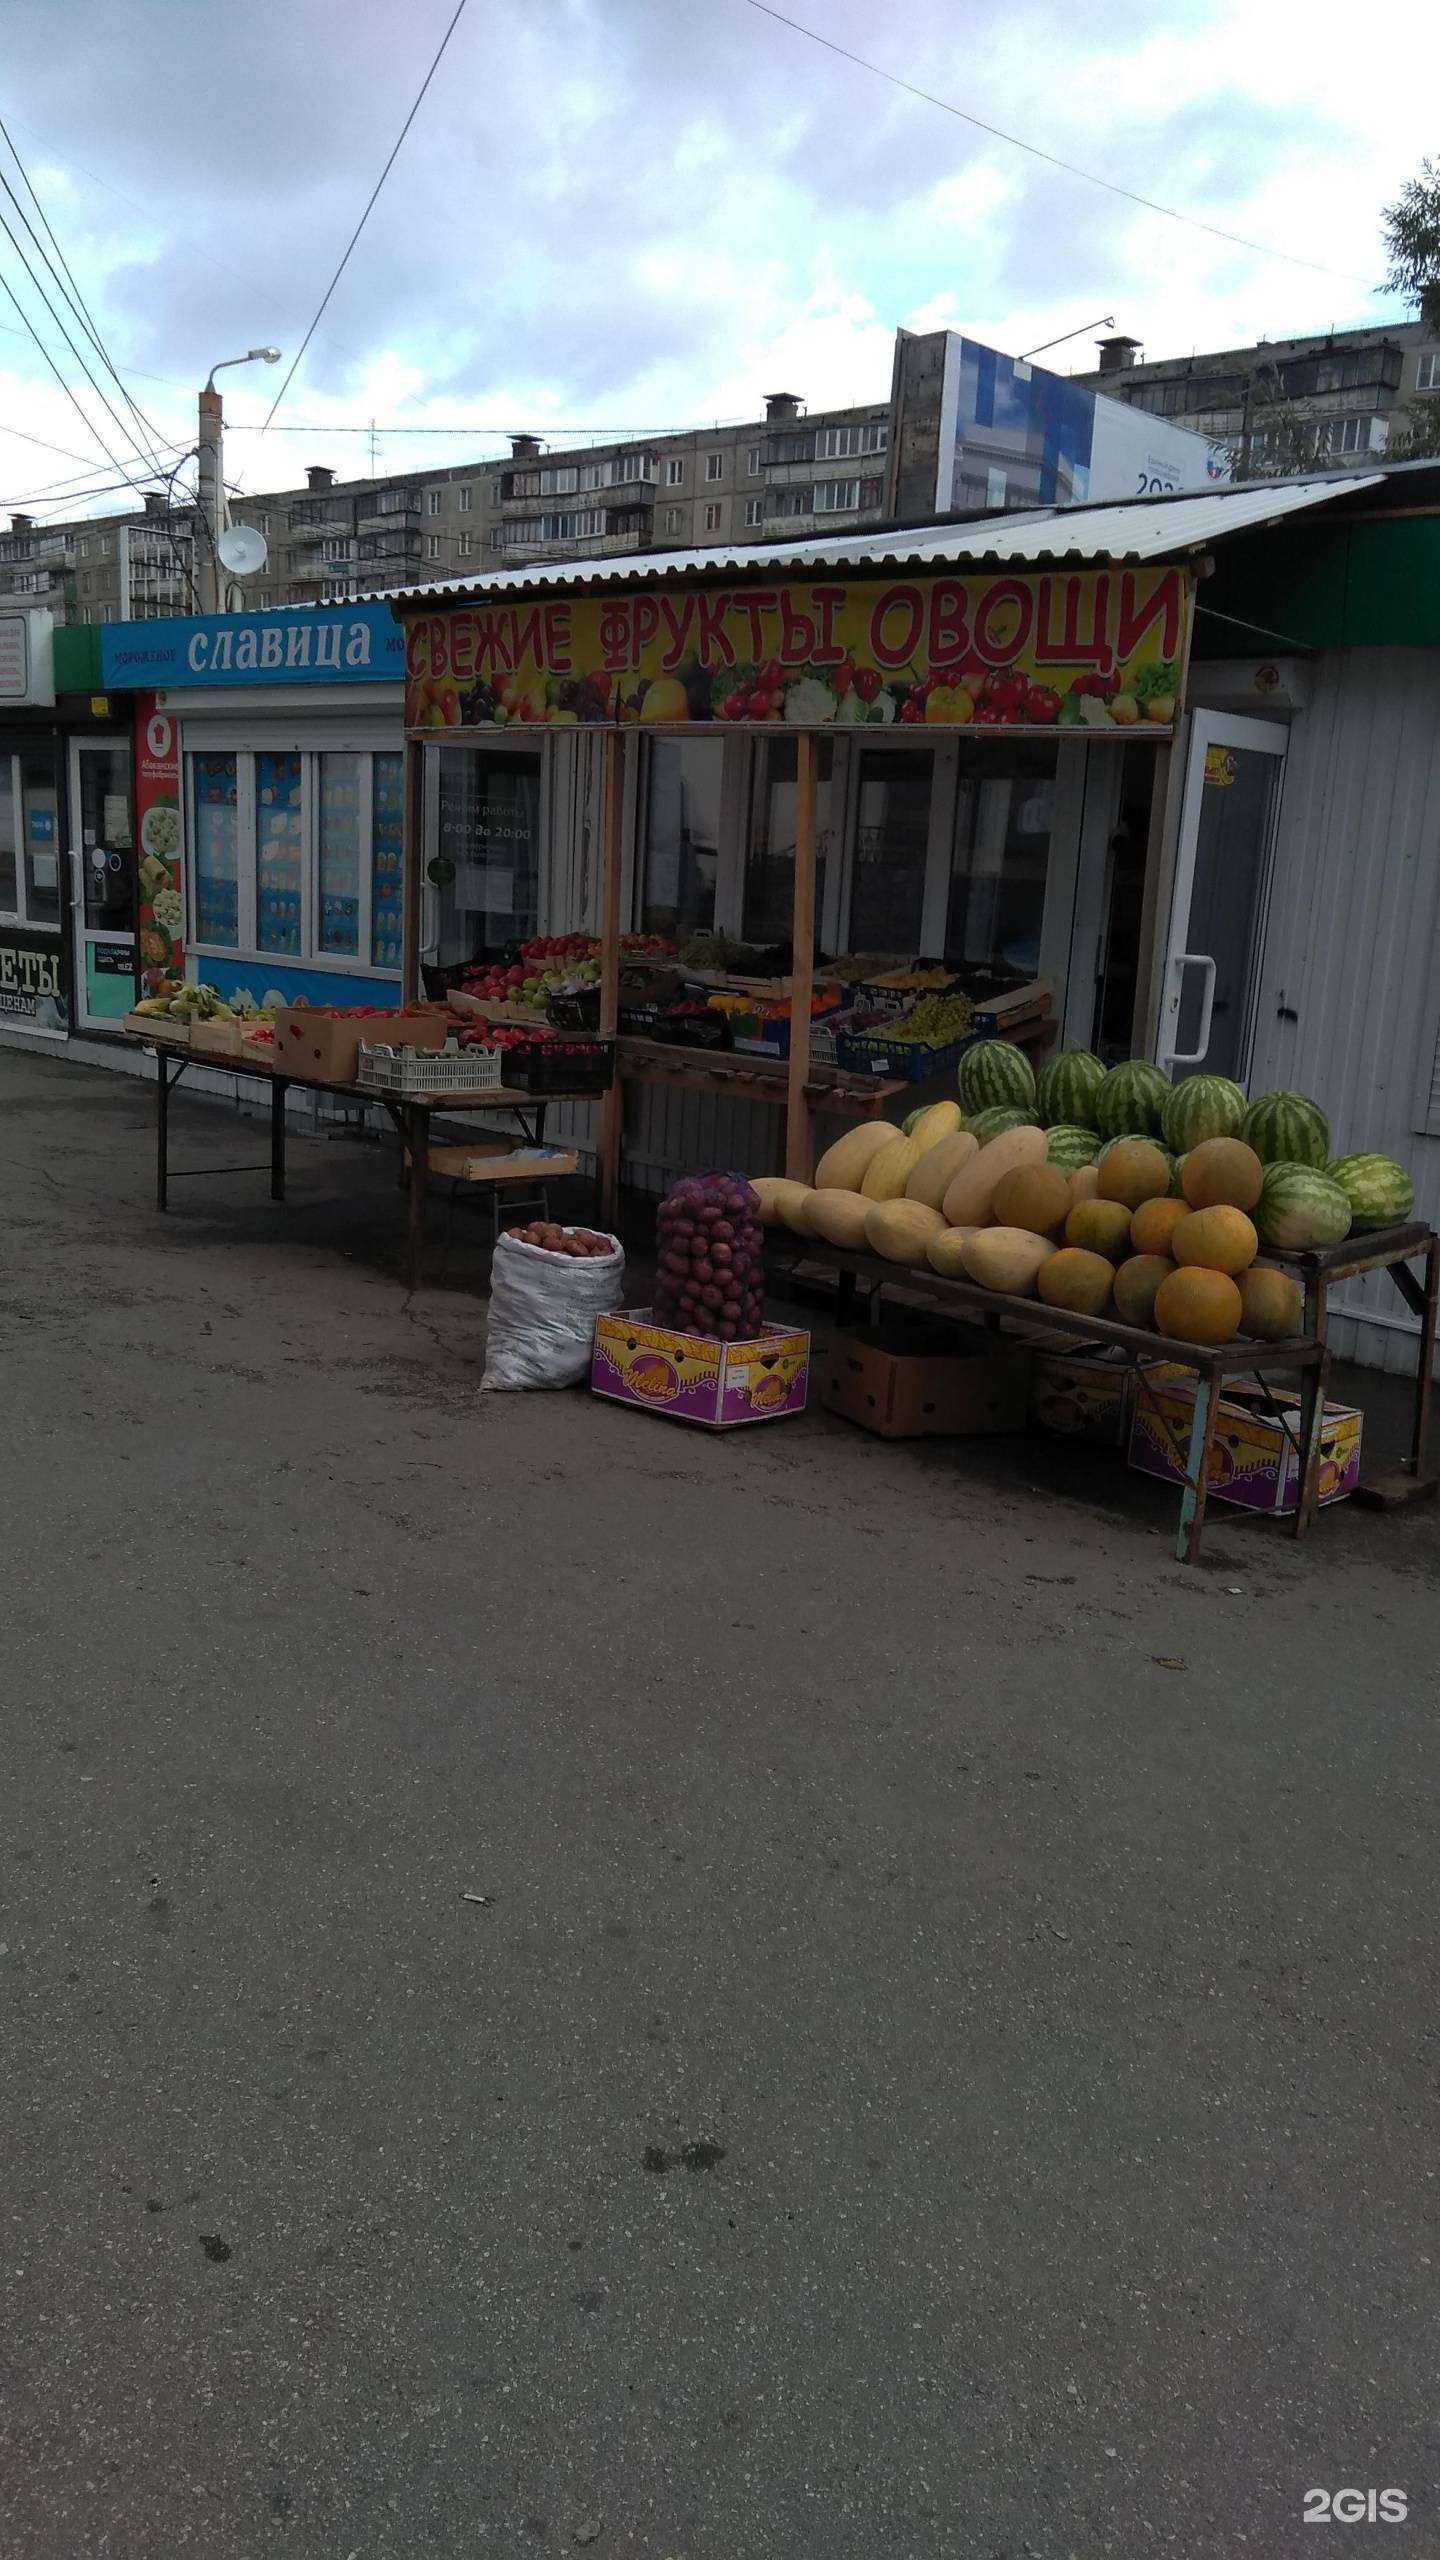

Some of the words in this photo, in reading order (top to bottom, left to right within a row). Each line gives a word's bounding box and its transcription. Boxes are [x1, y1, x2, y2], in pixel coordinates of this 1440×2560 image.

[405, 601, 572, 679] СВЕЖИЕ
[600, 588, 847, 672] ФРУКТЫ
[869, 569, 1181, 678] ОВОЩИ
[495, 827, 532, 840] 20:00
